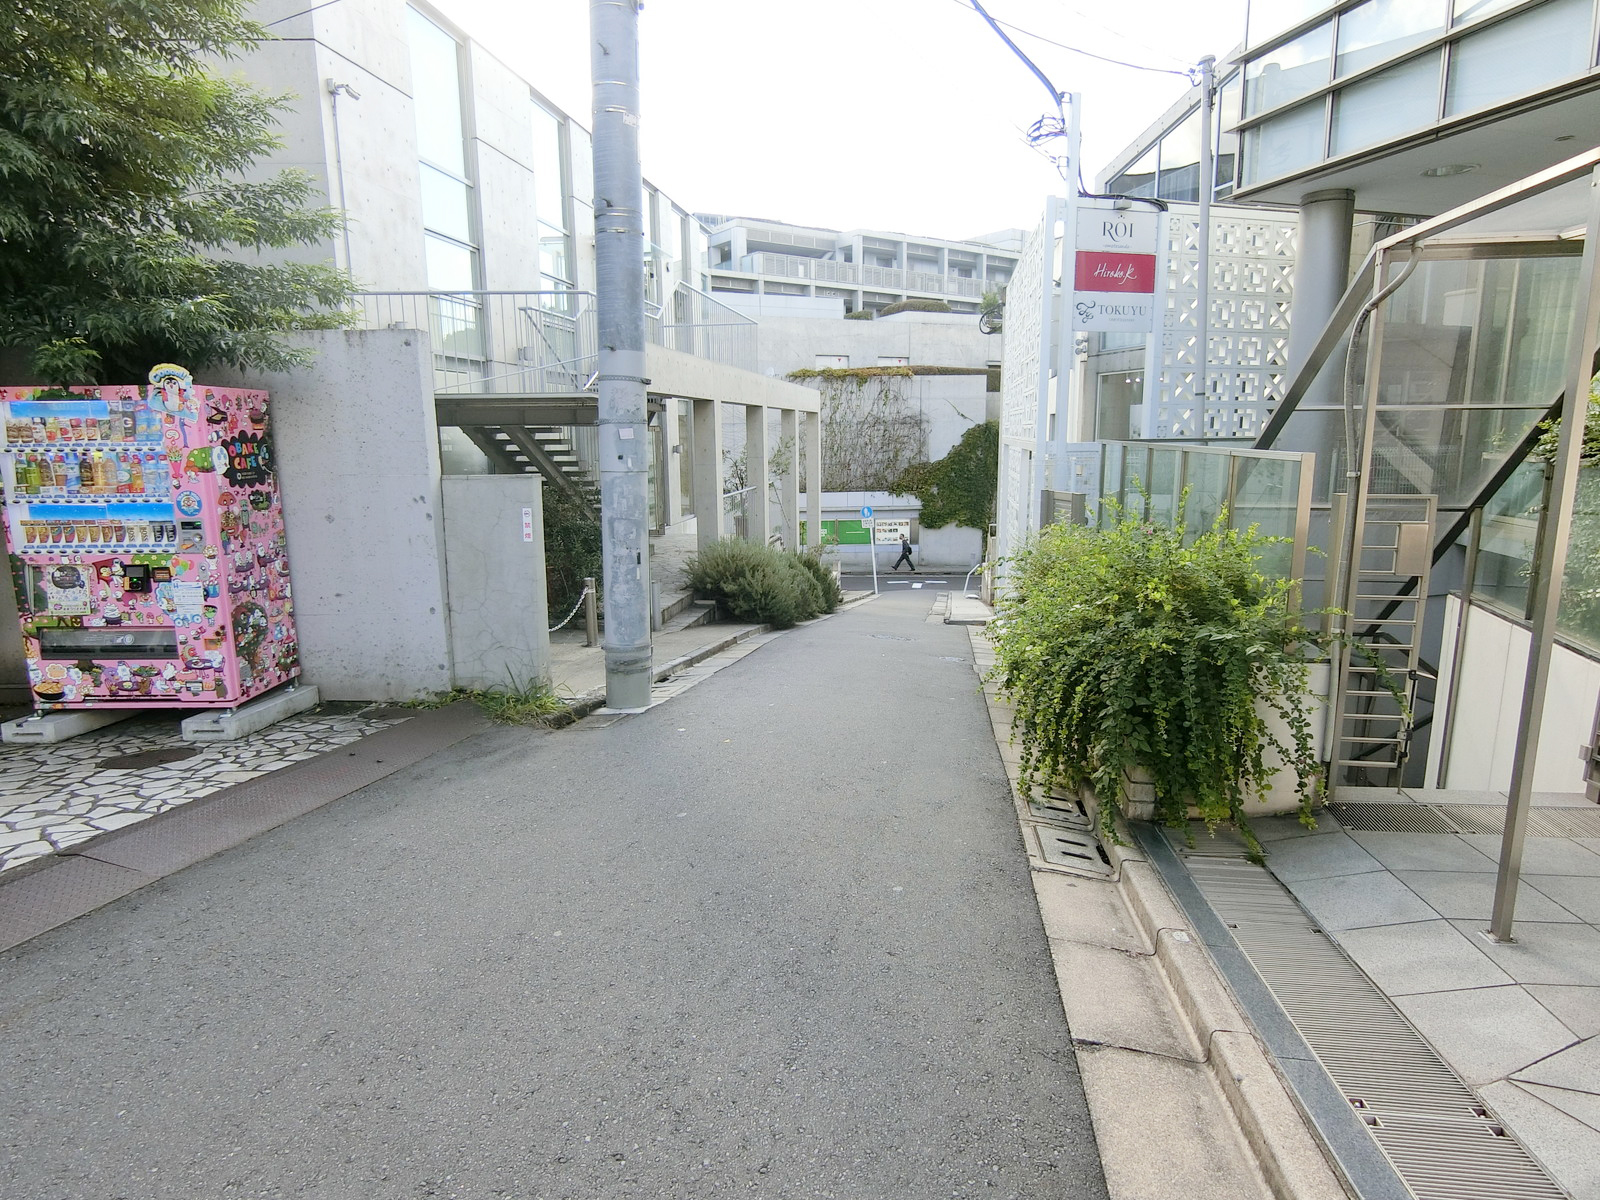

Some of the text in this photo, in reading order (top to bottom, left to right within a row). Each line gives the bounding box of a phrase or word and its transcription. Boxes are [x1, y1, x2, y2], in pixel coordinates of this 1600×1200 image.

[1102, 221, 1134, 242] ROI
[1098, 304, 1147, 316] TOKUYU
[228, 442, 259, 457] OBAKE
[234, 455, 257, 469] CAFE
